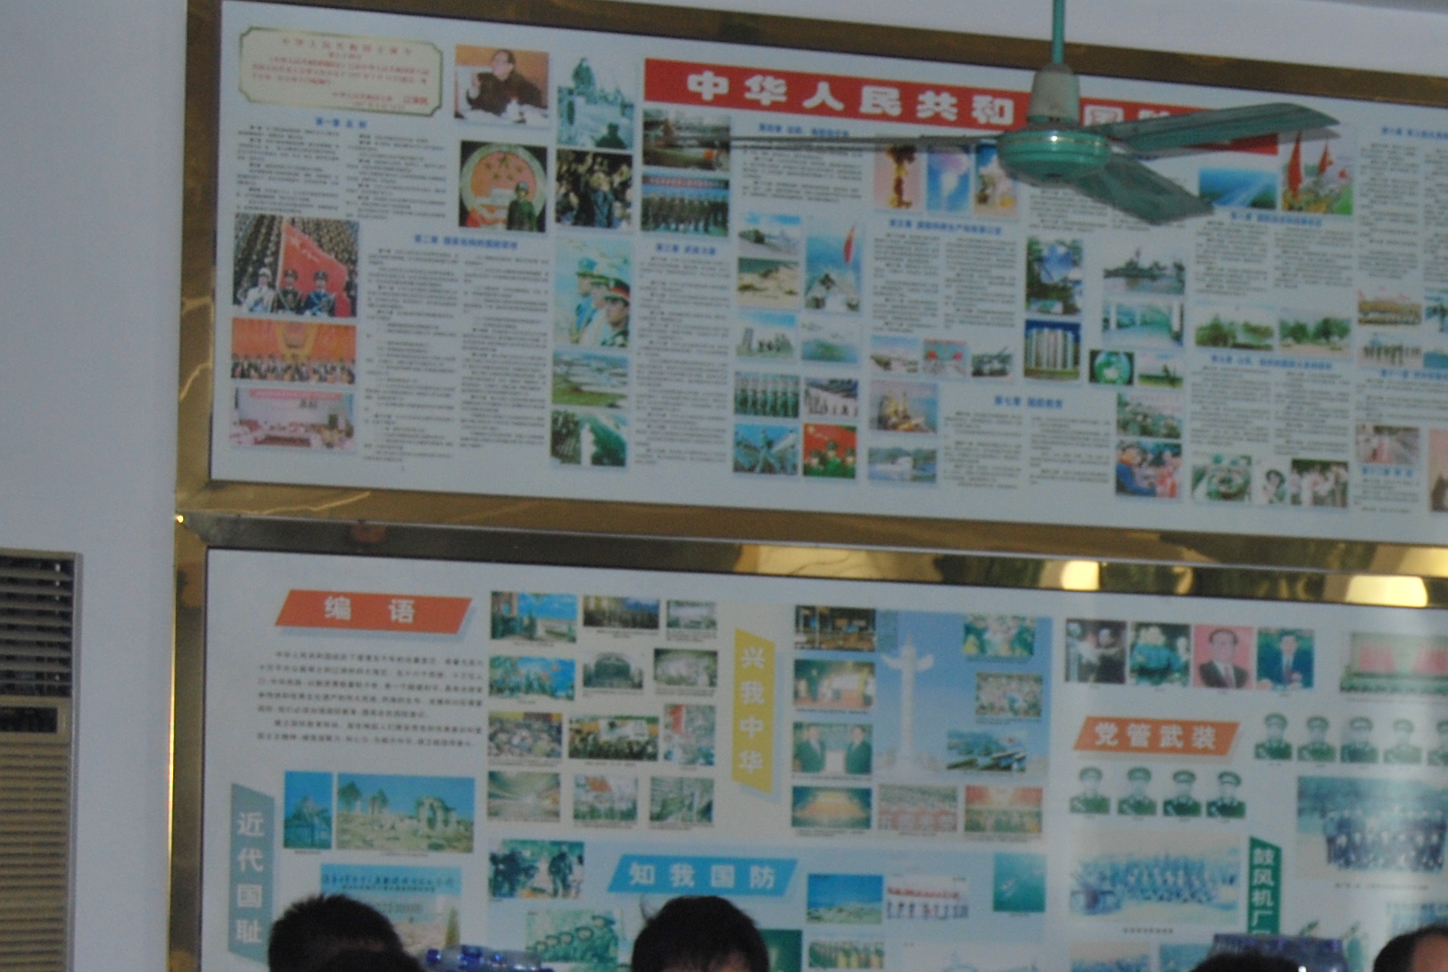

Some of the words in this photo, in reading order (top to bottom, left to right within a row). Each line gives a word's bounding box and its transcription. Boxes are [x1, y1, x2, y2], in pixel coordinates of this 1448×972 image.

[739, 646, 766, 775] 兴我中华
[1094, 722, 1217, 750] 党管武装
[236, 811, 265, 944] 近代国耻
[628, 862, 776, 889] 知我国防
[1252, 847, 1275, 935] 鼓风机厂
